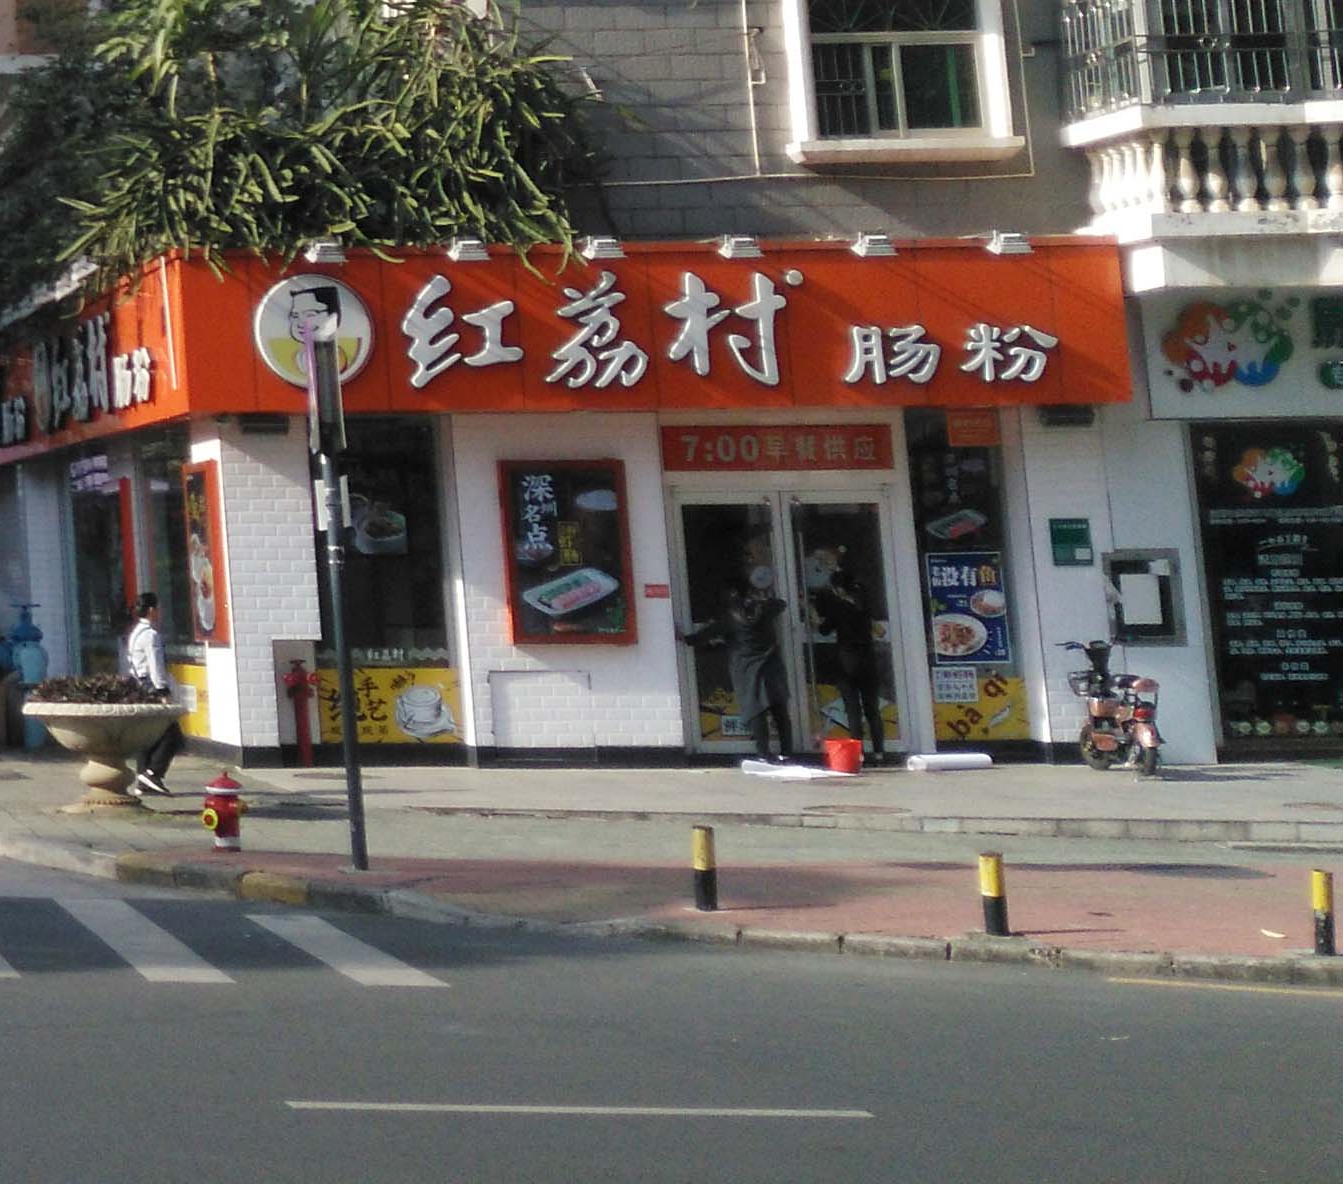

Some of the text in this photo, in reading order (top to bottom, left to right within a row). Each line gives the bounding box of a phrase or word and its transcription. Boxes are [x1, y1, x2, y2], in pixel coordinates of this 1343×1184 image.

[401, 270, 1058, 389] 红荔村 肠粉
